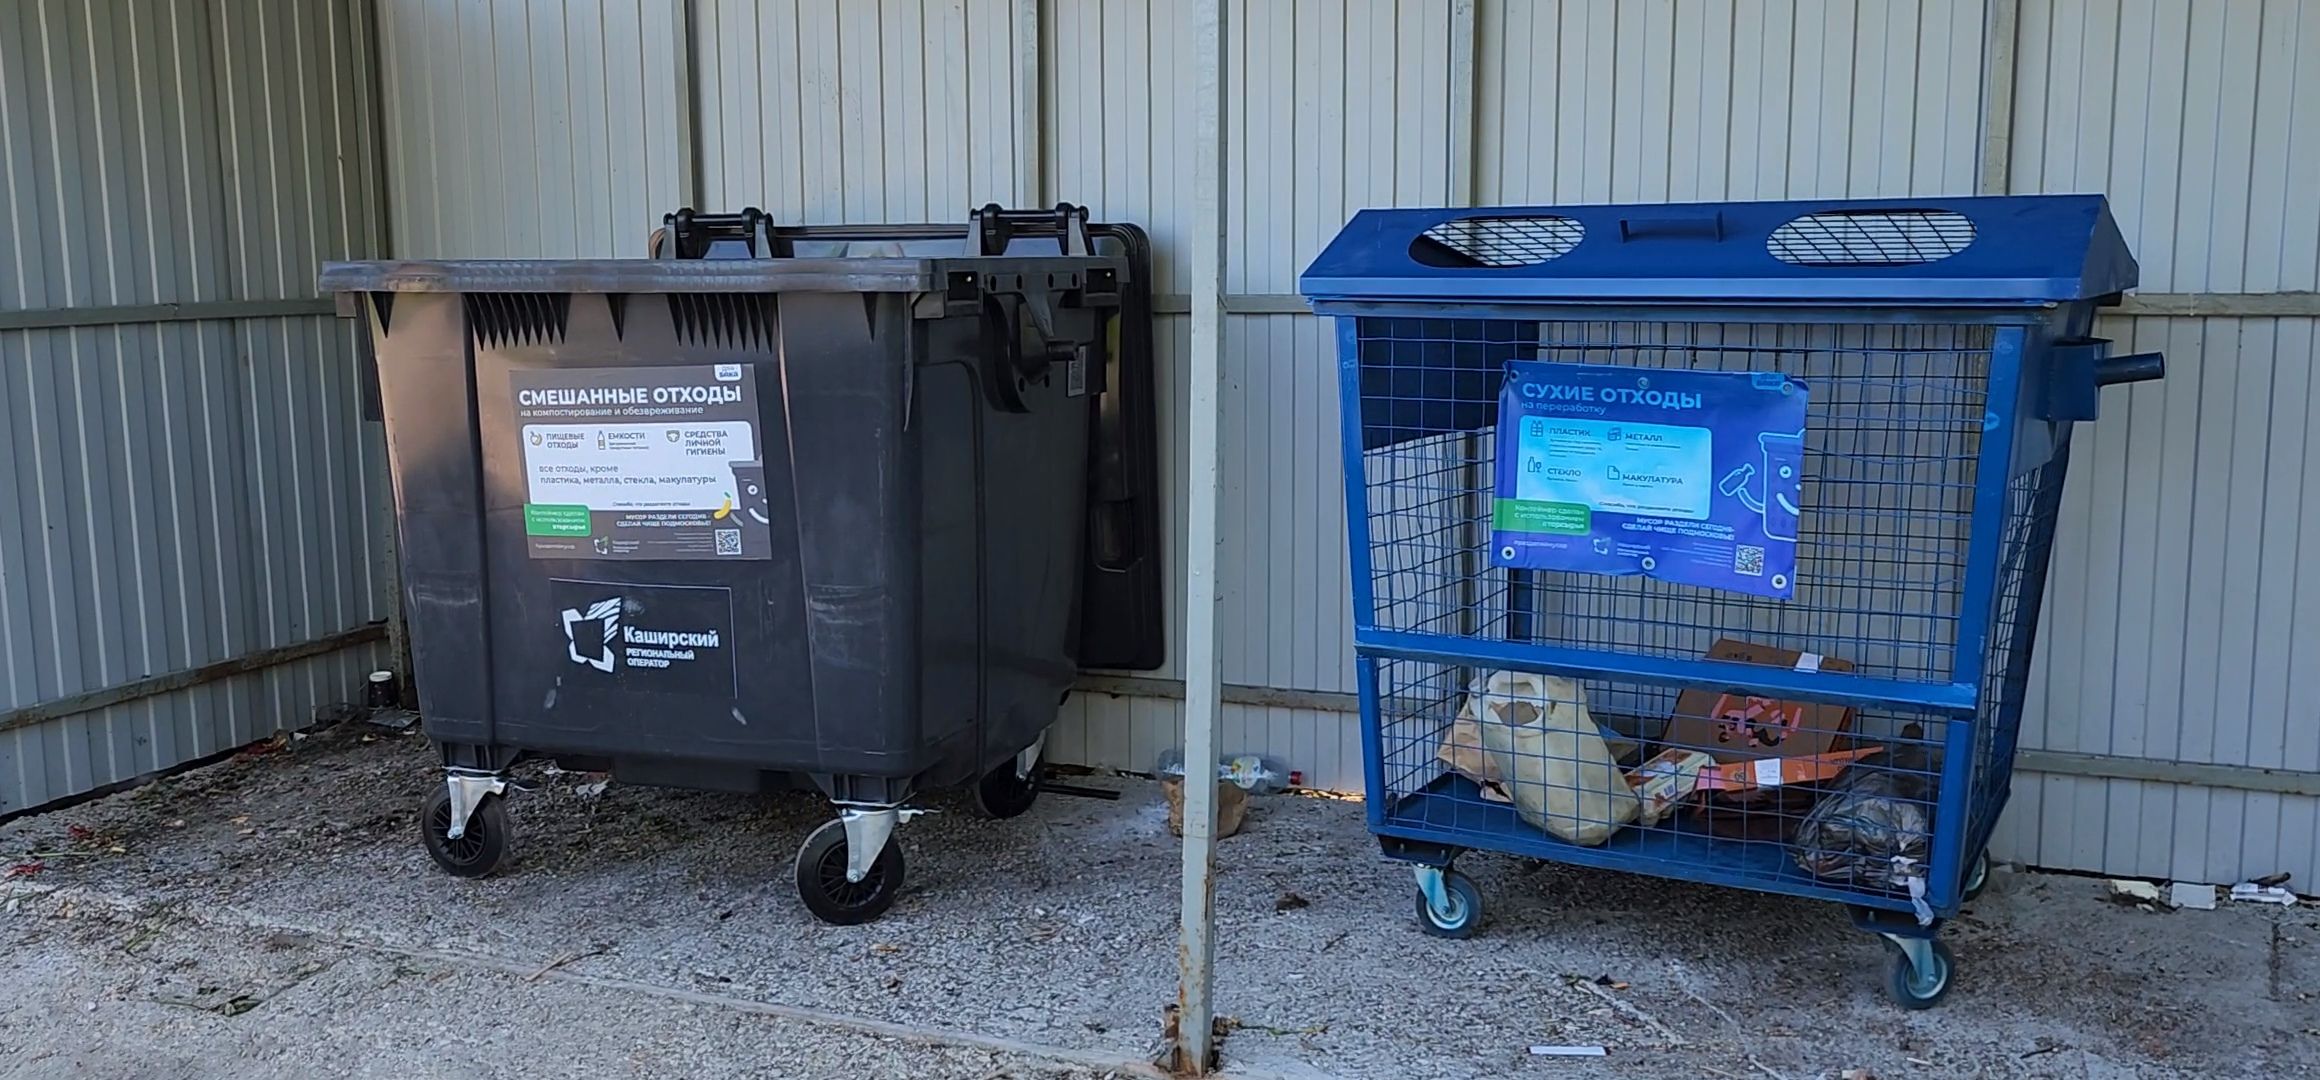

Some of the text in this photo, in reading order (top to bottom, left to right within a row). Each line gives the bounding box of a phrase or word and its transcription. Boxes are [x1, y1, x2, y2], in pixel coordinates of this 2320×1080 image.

[518, 385, 742, 406] СМЕШАННЫЕ ОТХОДЫ
[1522, 382, 1701, 410] СУХИЕ ОТХОДЫ
[520, 405, 704, 418] на компостирование и обезвреживание
[1520, 401, 1606, 416] на переработку
[546, 432, 585, 441] ПИЩЕВЫЕ
[608, 432, 645, 440] ЕМКОСТИ
[684, 430, 728, 440] СРЕДСТВА
[1548, 427, 1663, 442] ПЛАСТИК МЕТАЛЛ
[547, 440, 579, 449] ОТХОДЫ
[685, 438, 721, 447] ЛИЧНОЙ
[686, 447, 726, 456] ГИГИЕНЫ
[539, 464, 619, 475] все отходы, кроме
[540, 476, 717, 486] пластика, металла, стекла, макулатуры
[1546, 467, 1684, 485] СТЕКЛО МАКУЛАТУРА
[623, 626, 719, 649] Каширский
[625, 647, 695, 660] РЕГИОНАЛЬНЫЙ
[626, 657, 670, 668] ОПЕРАТОР
